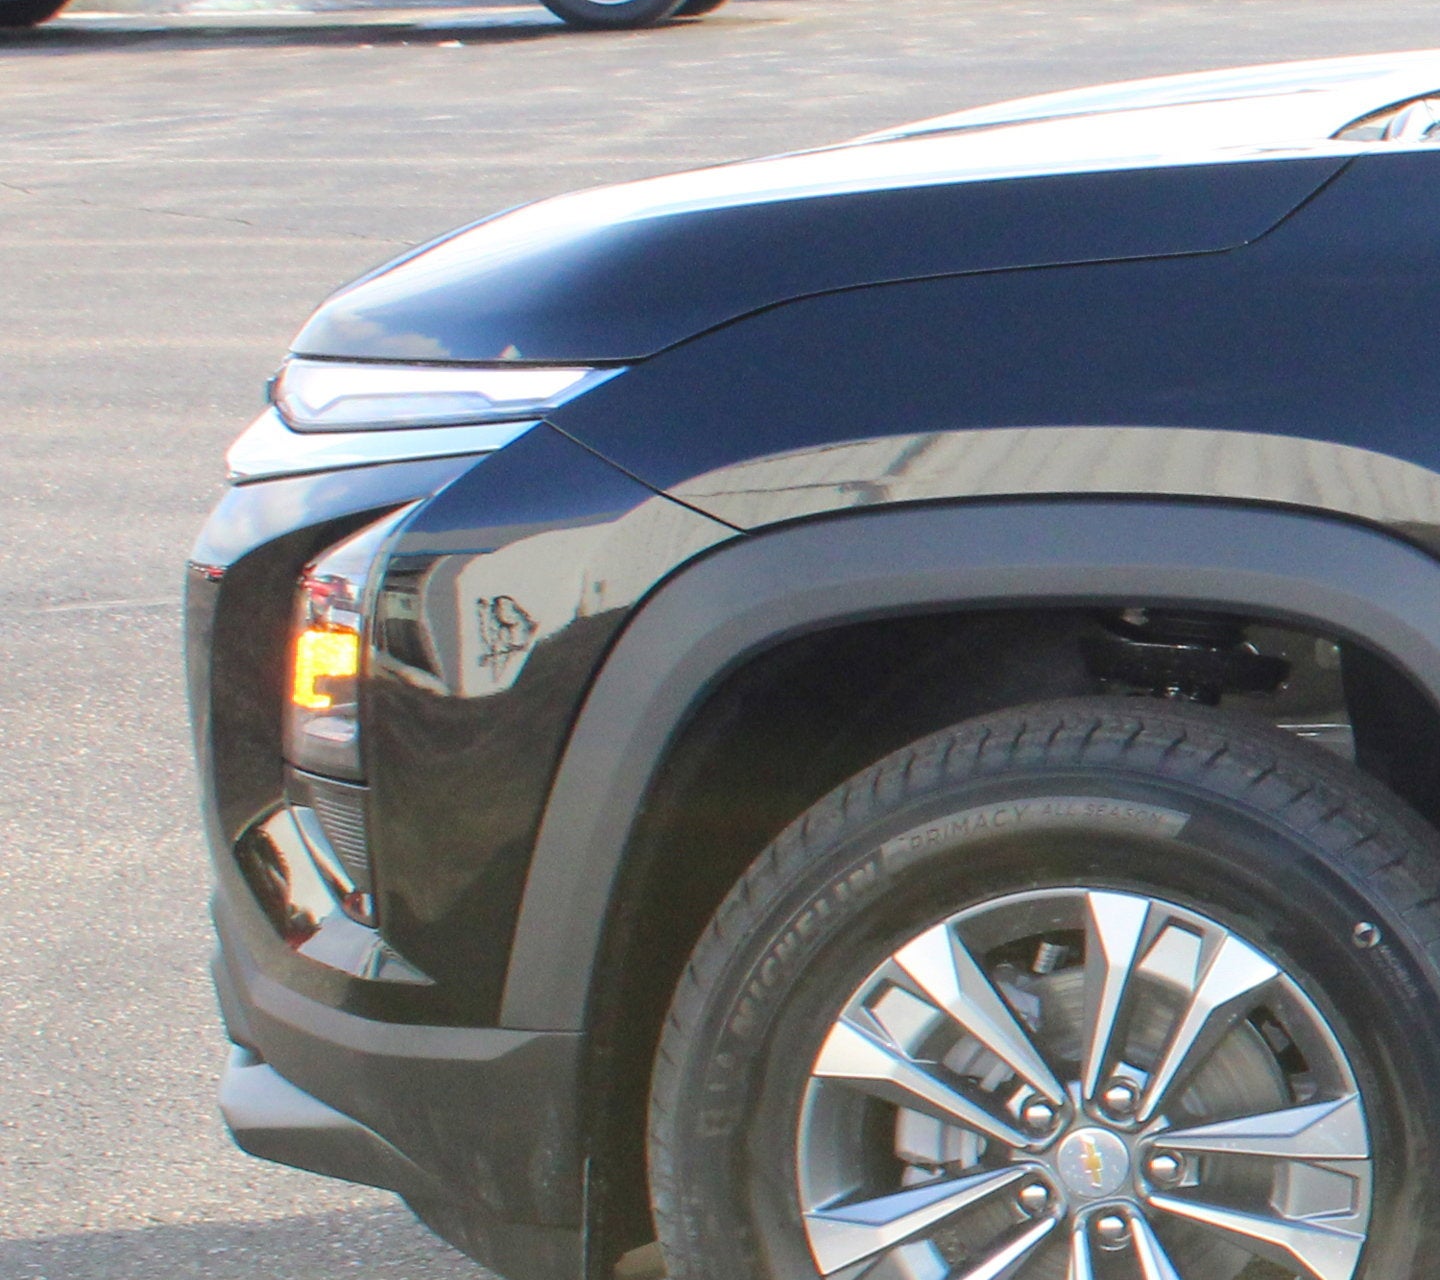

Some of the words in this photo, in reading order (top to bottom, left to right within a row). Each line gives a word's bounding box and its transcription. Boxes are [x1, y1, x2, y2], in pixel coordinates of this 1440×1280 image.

[910, 803, 1030, 850] PRIMACY
[1042, 802, 1084, 818] ALL
[1085, 803, 1161, 823] SEASON
[731, 861, 876, 1036] MICHELIN
